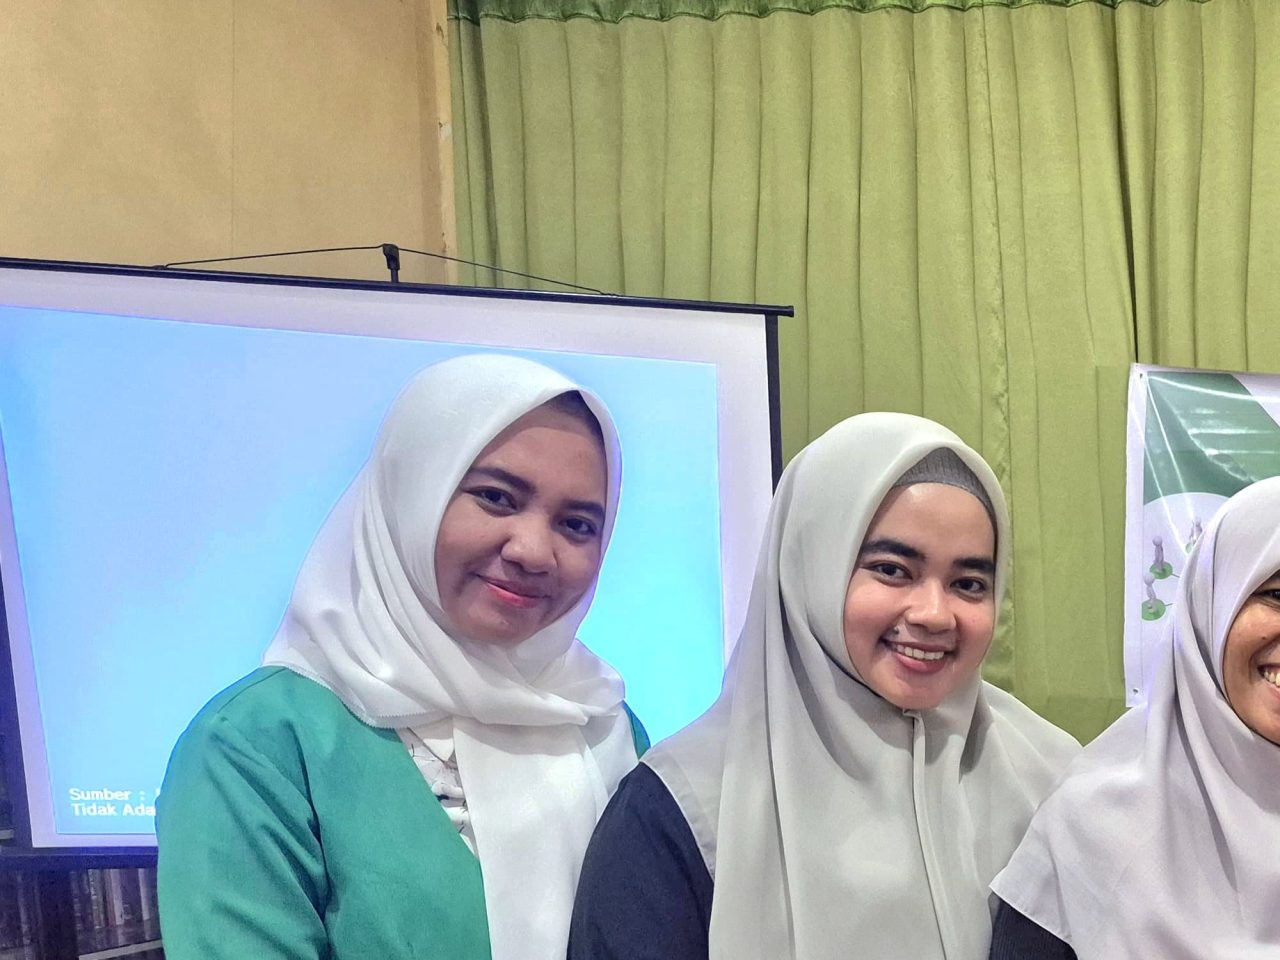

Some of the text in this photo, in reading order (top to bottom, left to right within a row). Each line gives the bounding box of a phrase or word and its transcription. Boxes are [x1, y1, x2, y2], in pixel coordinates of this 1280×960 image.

[69, 788, 132, 800] Sumber
[71, 803, 156, 816] Tidak Ada
